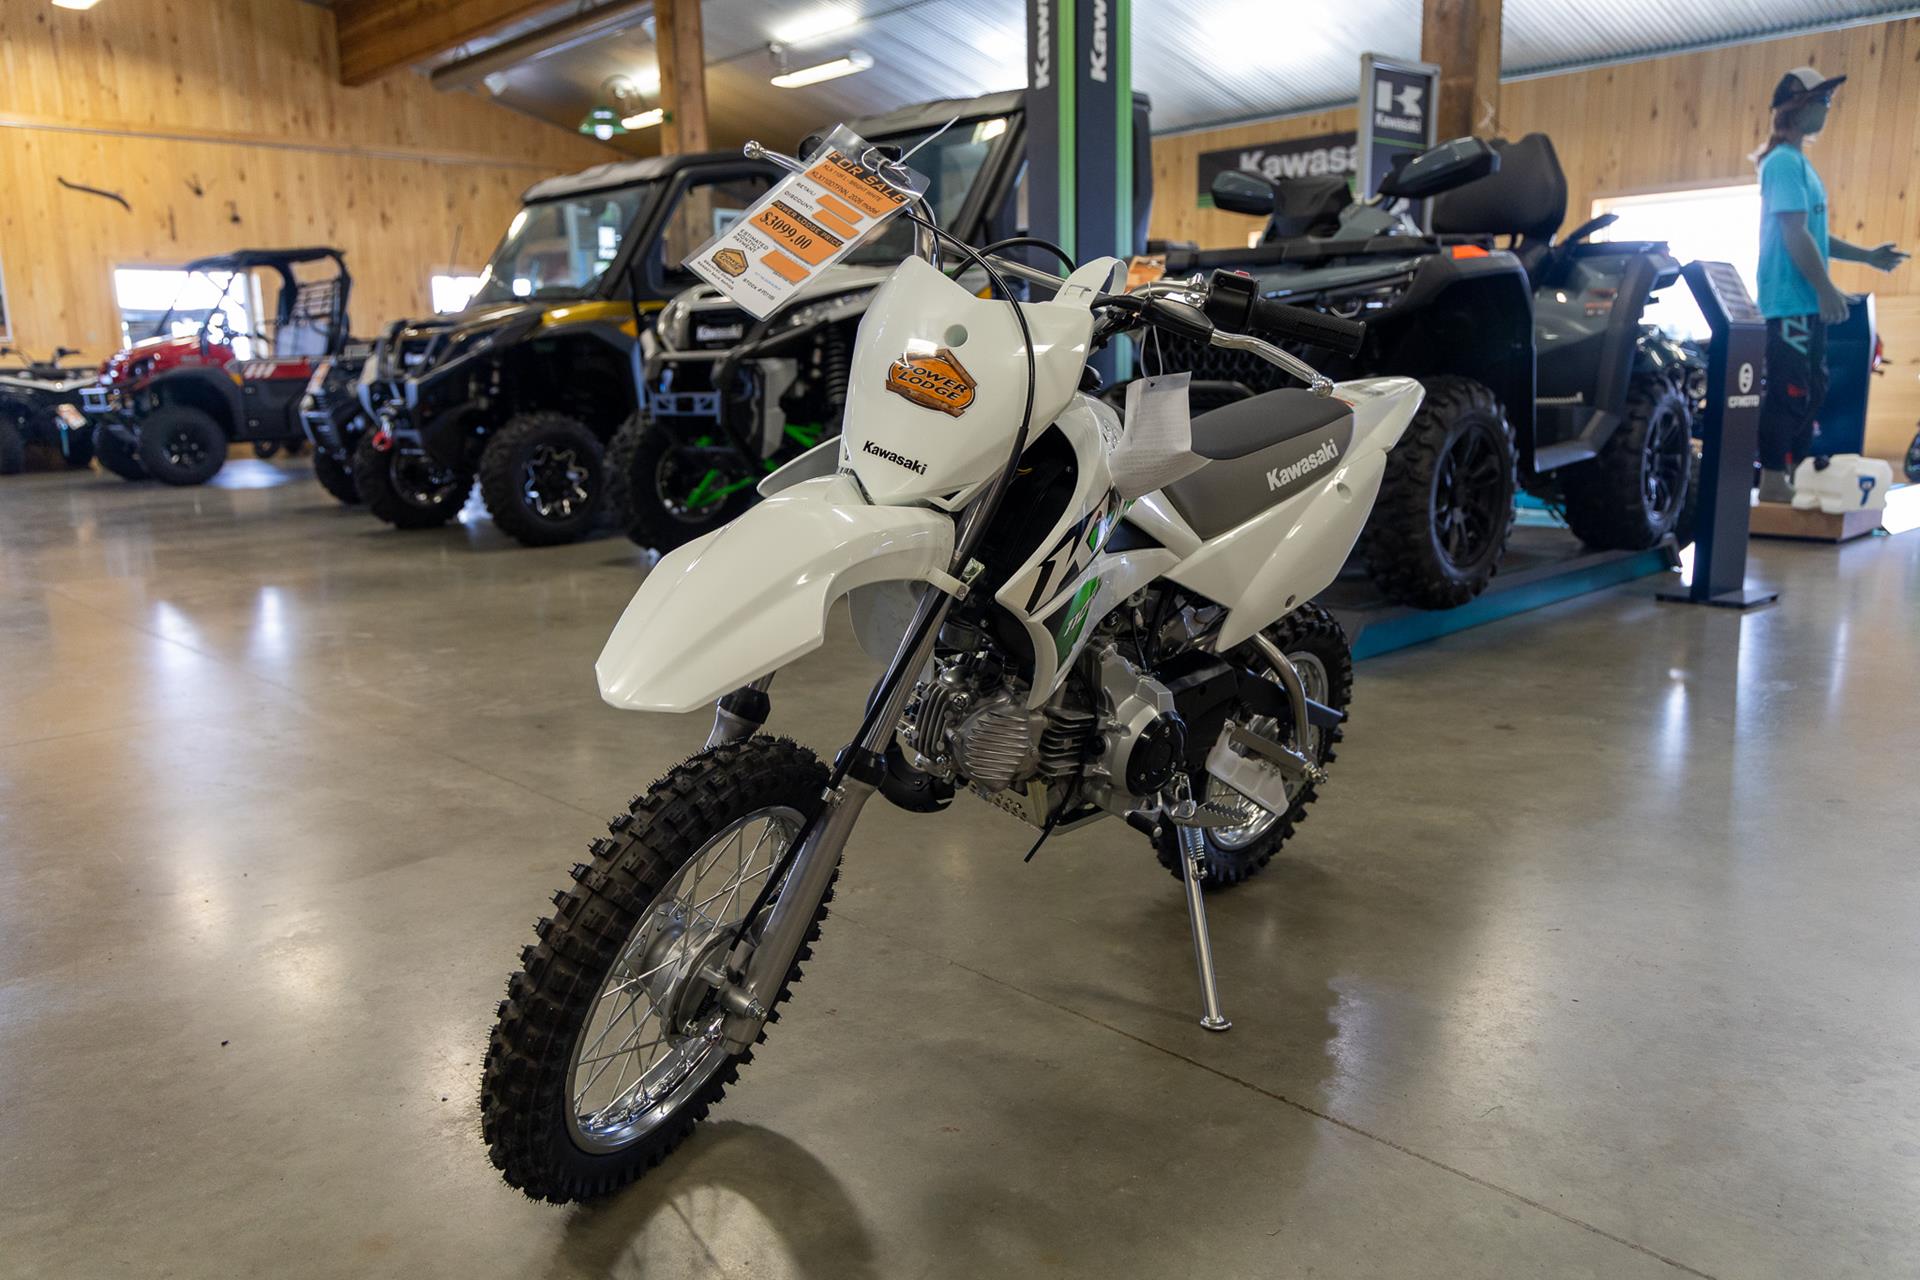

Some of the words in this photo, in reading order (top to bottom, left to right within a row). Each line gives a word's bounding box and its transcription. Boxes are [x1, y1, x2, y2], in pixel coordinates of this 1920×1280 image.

[1034, 0, 1050, 90] Kaw
[1375, 112, 1423, 134] Kawasaki
[827, 151, 863, 175] FOR
[862, 174, 907, 203] SALE
[774, 201, 796, 217] POWER
[797, 217, 820, 233] LODGE
[819, 231, 841, 247] PRICE
[861, 201, 879, 215] model
[739, 229, 769, 250] ESTIMATED
[758, 210, 813, 251] $3099.00
[897, 363, 968, 393] POWER
[898, 372, 961, 401] LODGE
[862, 440, 928, 476] Kawasaki
[1266, 438, 1340, 492] Kawasaki
